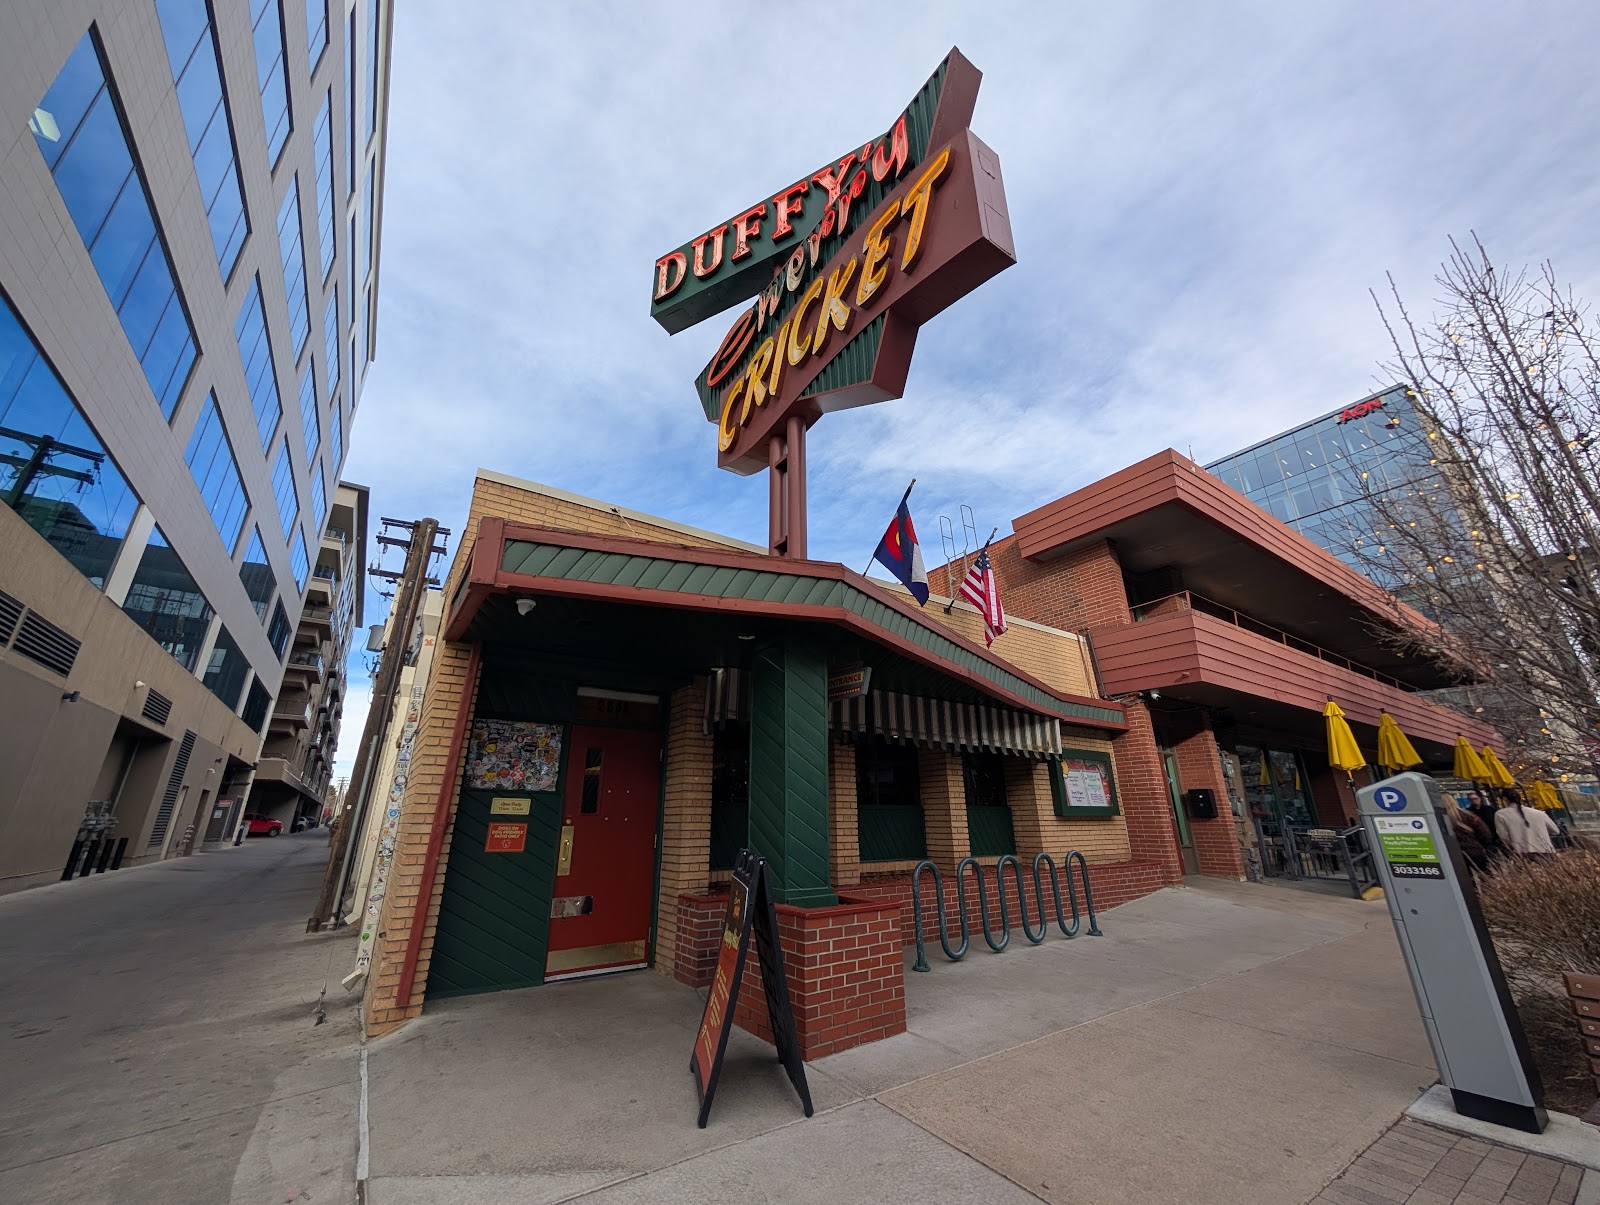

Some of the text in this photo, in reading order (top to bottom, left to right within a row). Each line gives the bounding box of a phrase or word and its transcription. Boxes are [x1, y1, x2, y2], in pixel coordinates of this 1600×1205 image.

[654, 142, 873, 301] DUFFY'
[719, 146, 952, 452] CRICKET
[1340, 398, 1382, 422] AON
[829, 673, 862, 688] NTRANCE
[1381, 791, 1399, 808] P
[1393, 866, 1440, 875] 3033166
